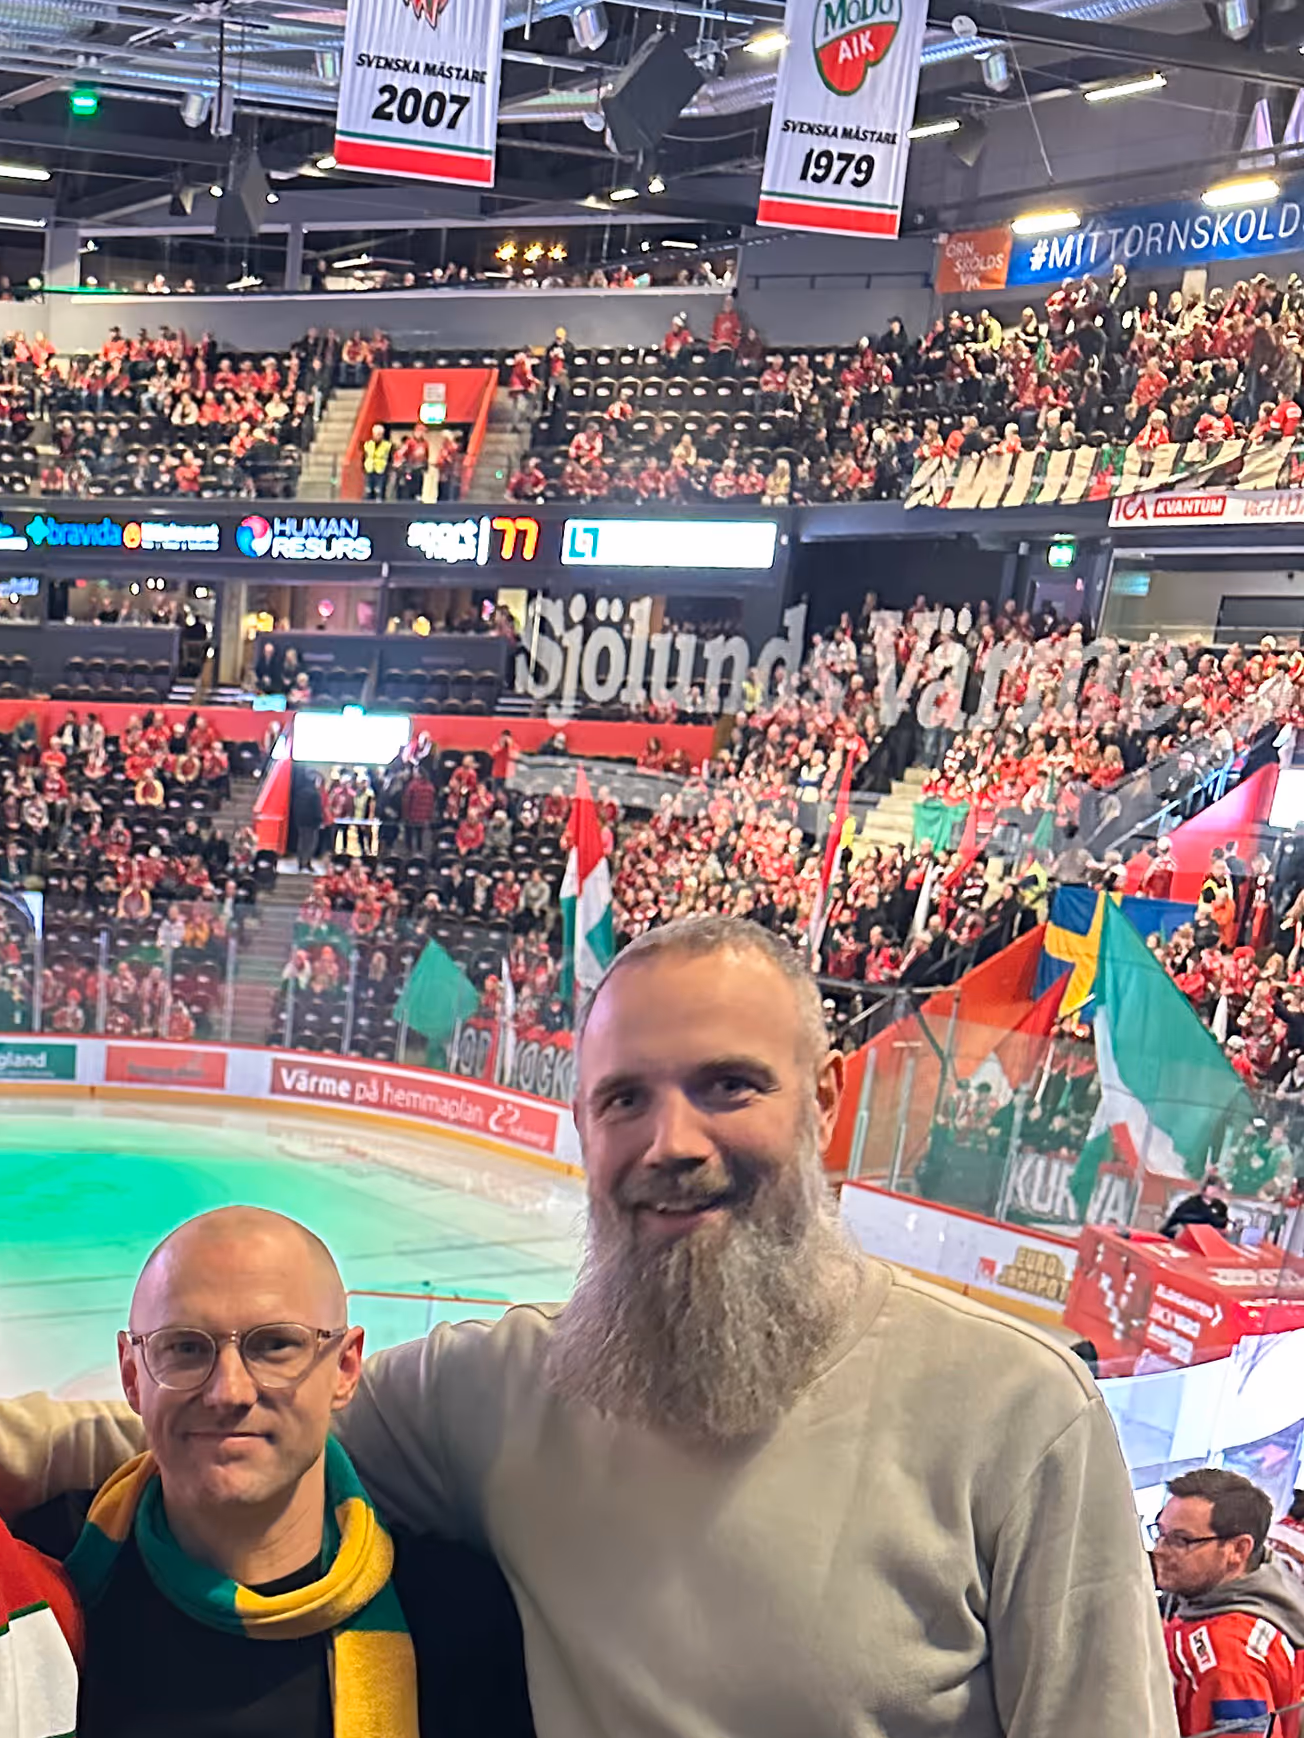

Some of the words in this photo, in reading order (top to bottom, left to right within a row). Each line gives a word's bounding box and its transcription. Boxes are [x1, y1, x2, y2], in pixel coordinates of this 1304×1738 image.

[838, 31, 874, 65] AIK
[355, 53, 421, 75] SVENSKA
[423, 60, 487, 84] MÄSTARE
[372, 84, 470, 129] 2007
[781, 119, 839, 138] SVENSKA
[841, 127, 897, 145] MÄSTARE
[799, 148, 875, 188] 1979
[1029, 202, 1304, 272] #MITTORNSKOLD
[1113, 496, 1149, 521] ICA
[1155, 498, 1224, 517] KVANTUM
[47, 517, 122, 547] bravida
[273, 517, 359, 538] HUMAN
[493, 516, 540, 561] 77
[270, 536, 372, 560] RESURS
[280, 1066, 351, 1098] Värme
[354, 1081, 380, 1105] på
[383, 1084, 484, 1128] hemmaplan
[1015, 1246, 1060, 1277] EURO
